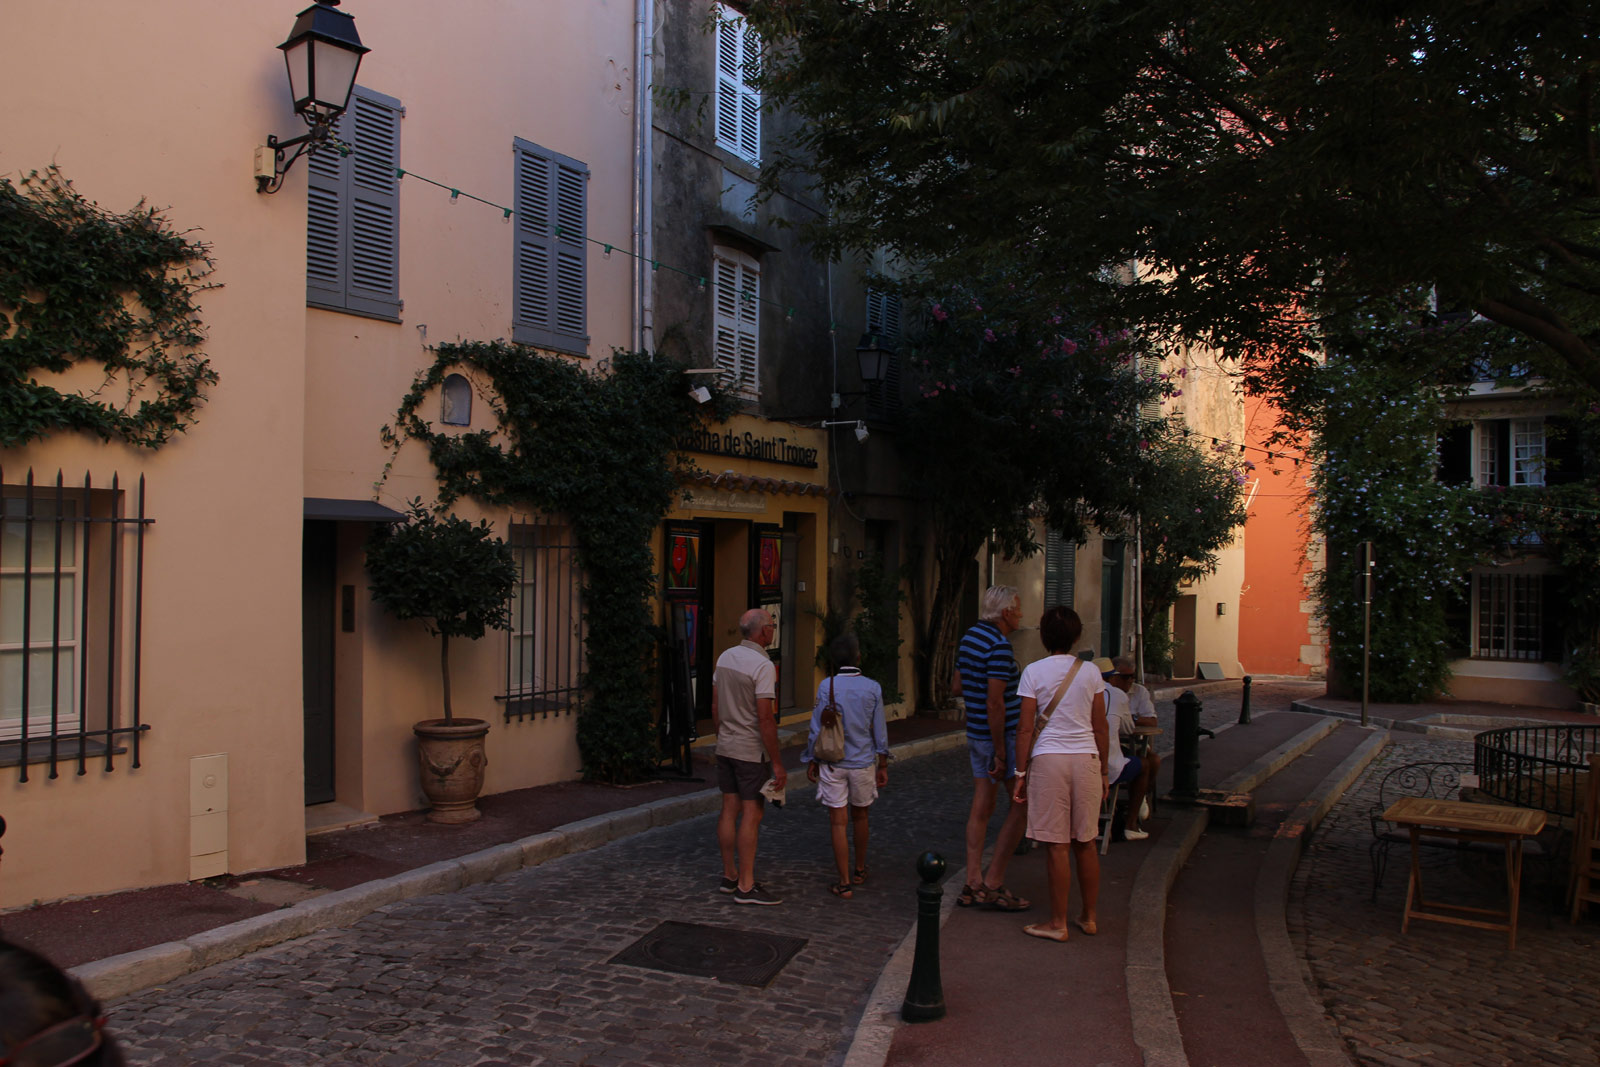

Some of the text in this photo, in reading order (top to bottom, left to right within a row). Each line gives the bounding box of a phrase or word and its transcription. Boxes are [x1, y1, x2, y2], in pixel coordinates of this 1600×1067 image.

[724, 429, 740, 453] de
[745, 432, 776, 458] Saint
[779, 438, 817, 464] Tropez
